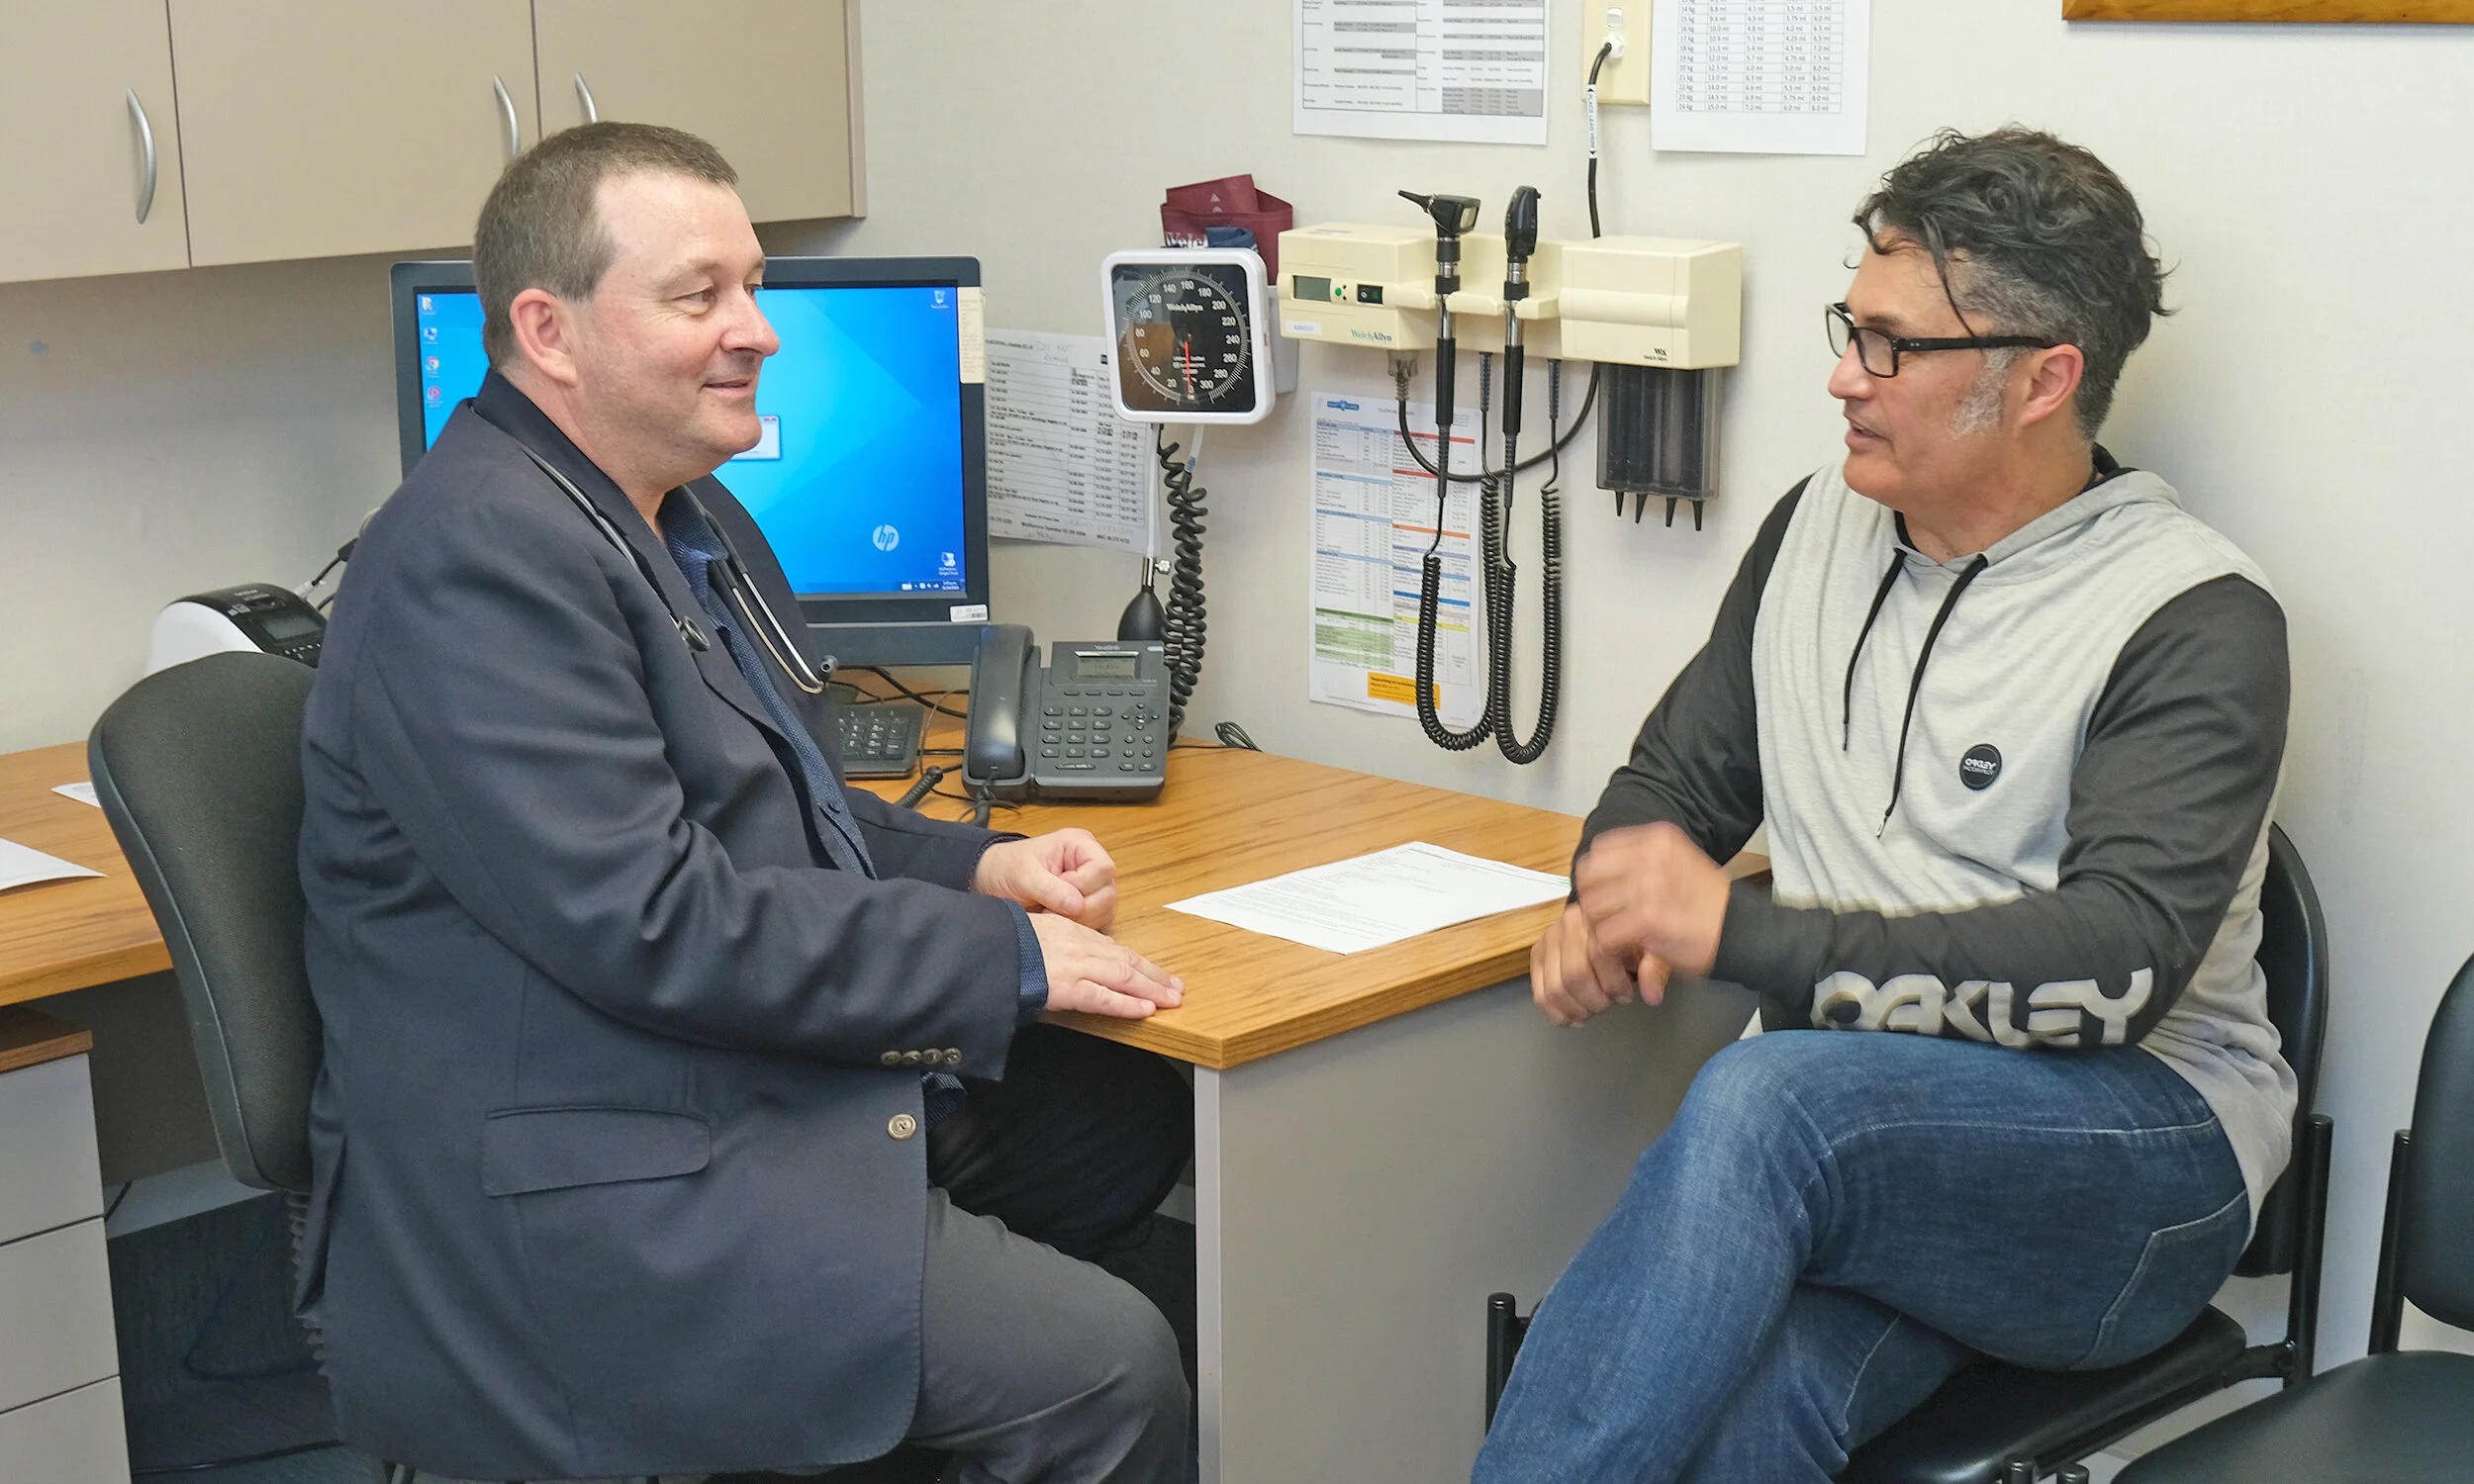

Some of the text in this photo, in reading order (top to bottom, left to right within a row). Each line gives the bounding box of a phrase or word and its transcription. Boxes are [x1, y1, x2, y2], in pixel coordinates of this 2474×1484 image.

[1163, 284, 1176, 293] 140
[1181, 280, 1194, 290] 160
[1198, 287, 1212, 297] 180
[1149, 294, 1162, 303] 120
[1212, 300, 1226, 311] 200
[1140, 310, 1152, 319] 100
[1222, 317, 1236, 326] 220
[1135, 328, 1145, 337] 80
[1226, 335, 1240, 345] 240
[1140, 348, 1150, 358] 60
[1223, 353, 1237, 363] 260
[1151, 366, 1161, 376] 40
[1214, 369, 1229, 378] 280
[1167, 378, 1177, 388] 20
[1200, 380, 1214, 389] 300
[1964, 758, 1997, 770] OAKLEY
[1810, 966, 2154, 1048] OAKLEY
